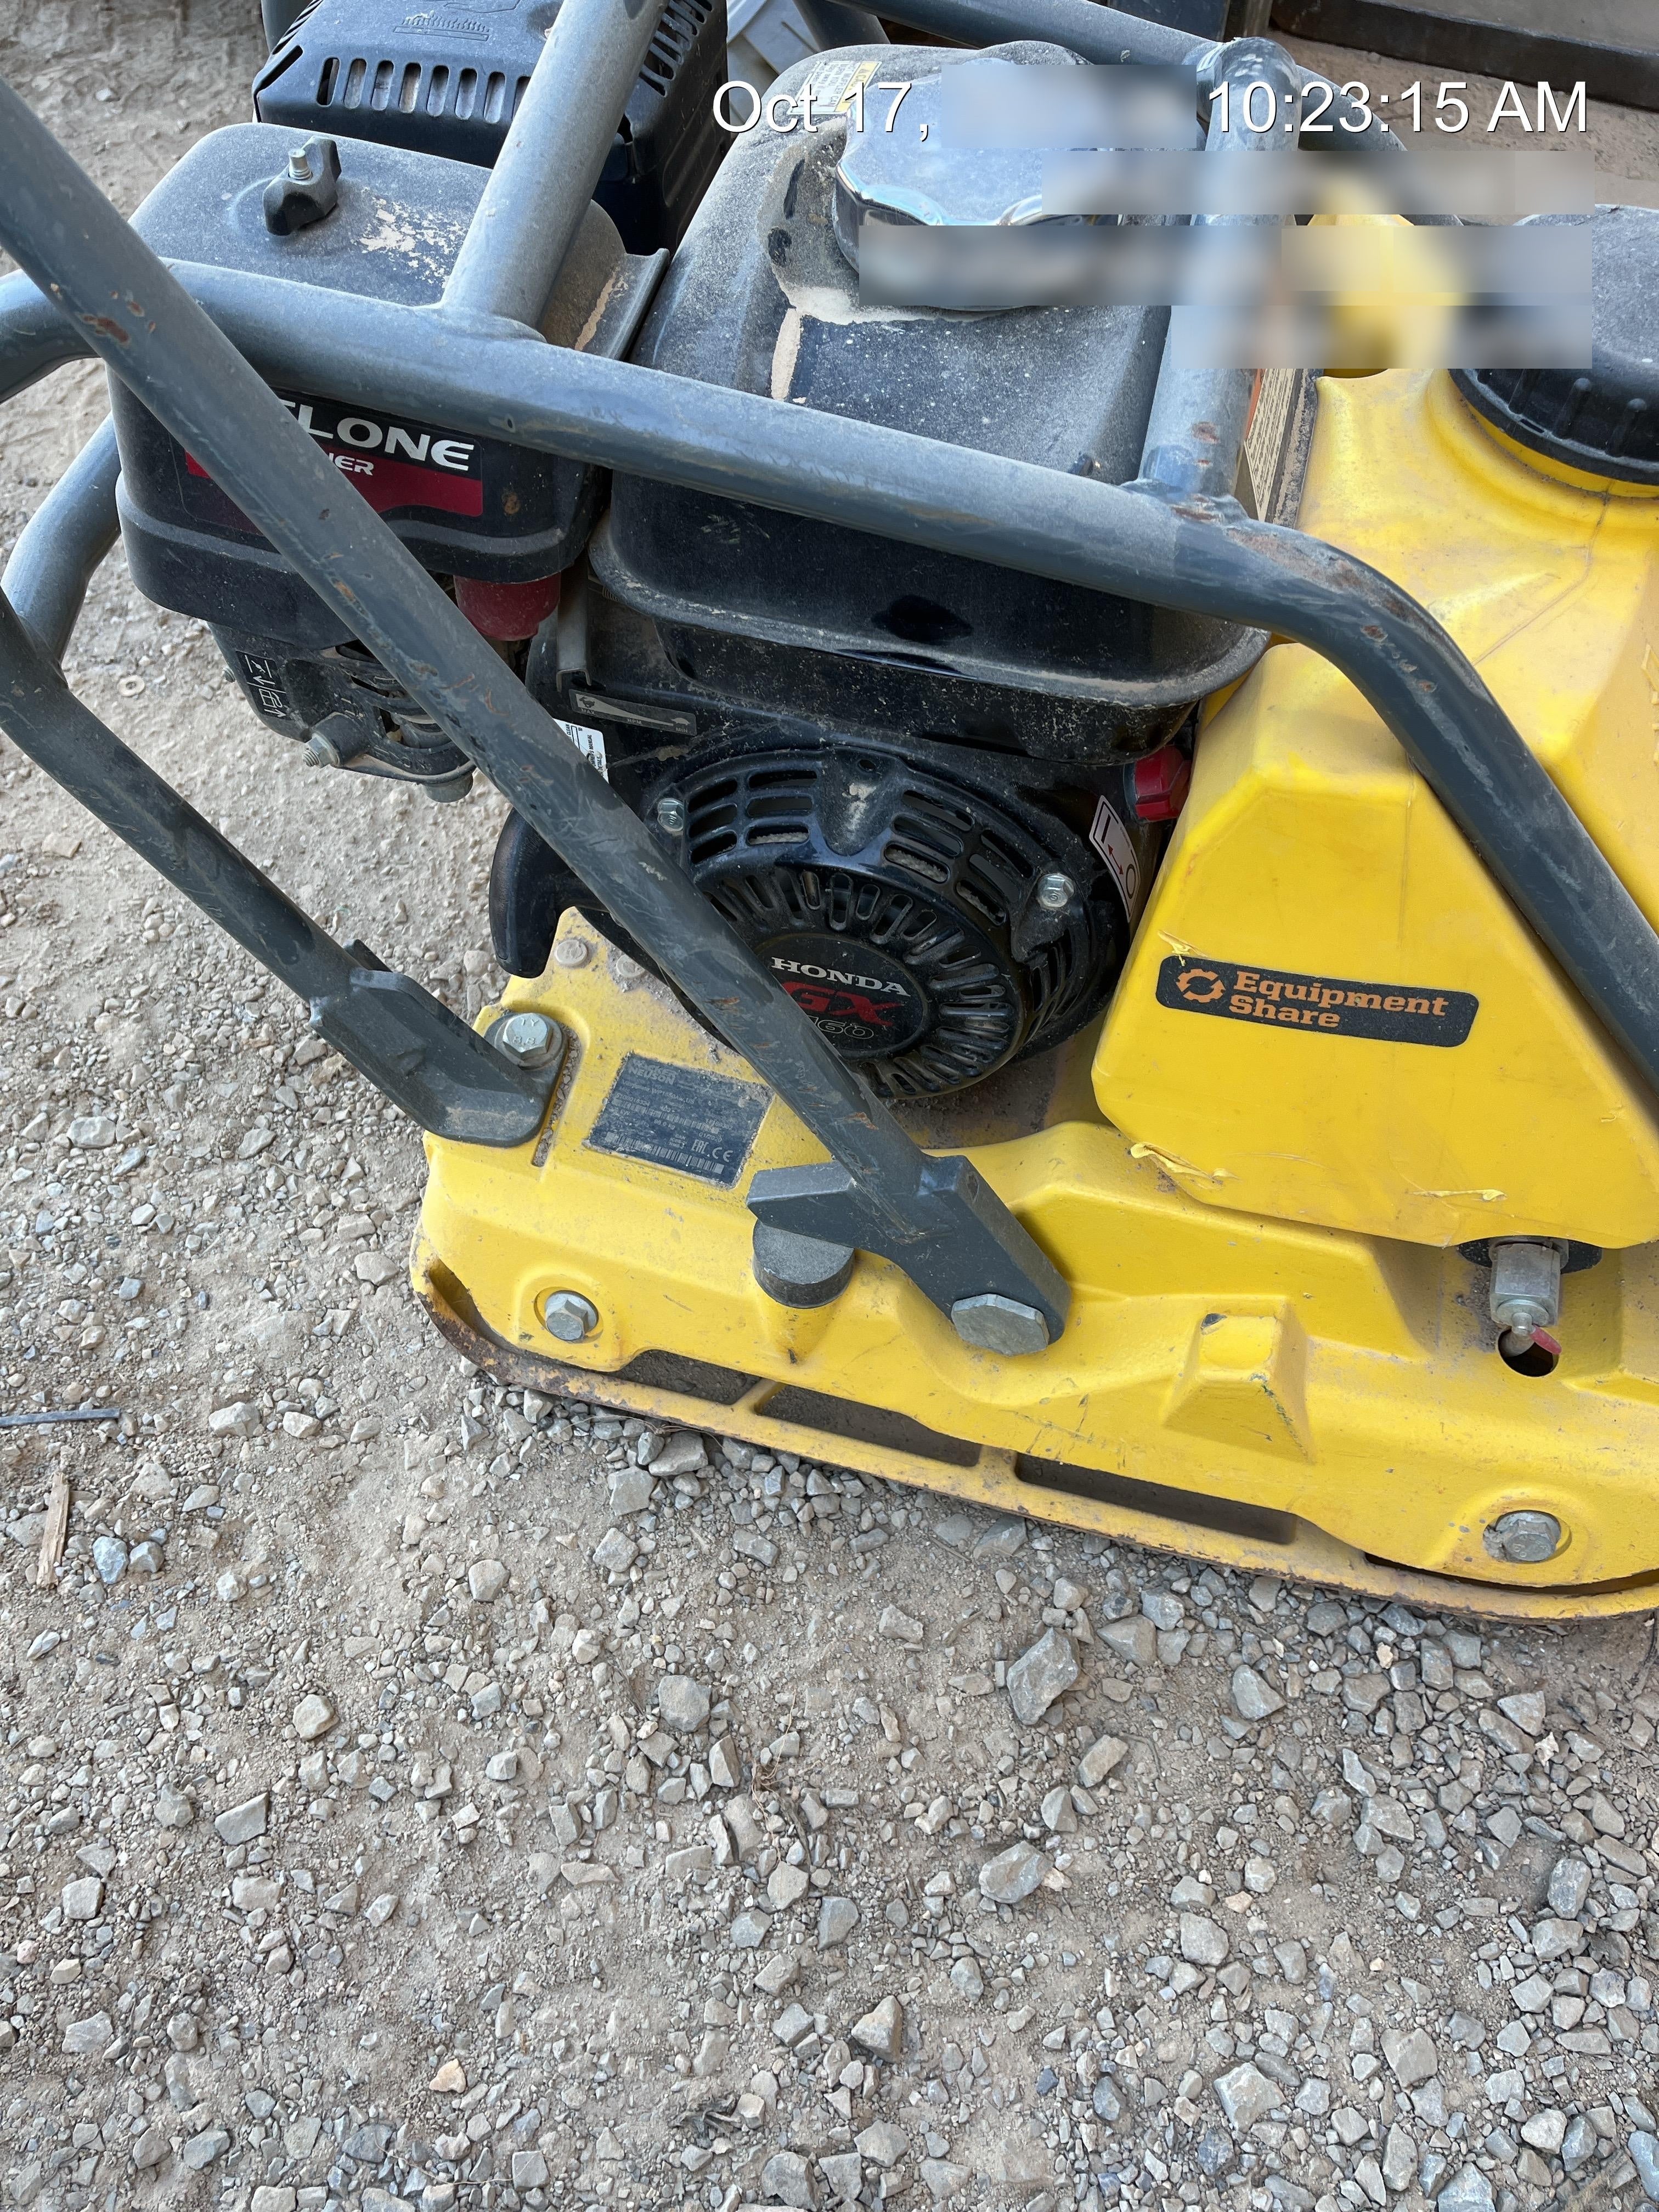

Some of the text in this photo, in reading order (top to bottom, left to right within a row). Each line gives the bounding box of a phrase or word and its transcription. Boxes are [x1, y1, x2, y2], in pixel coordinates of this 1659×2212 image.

[771, 957, 911, 997] HONDA
[1233, 970, 1449, 1017] Equipment
[782, 981, 905, 1027] GX
[1229, 995, 1341, 1028] Share
[629, 1066, 676, 1085] NEUSON
